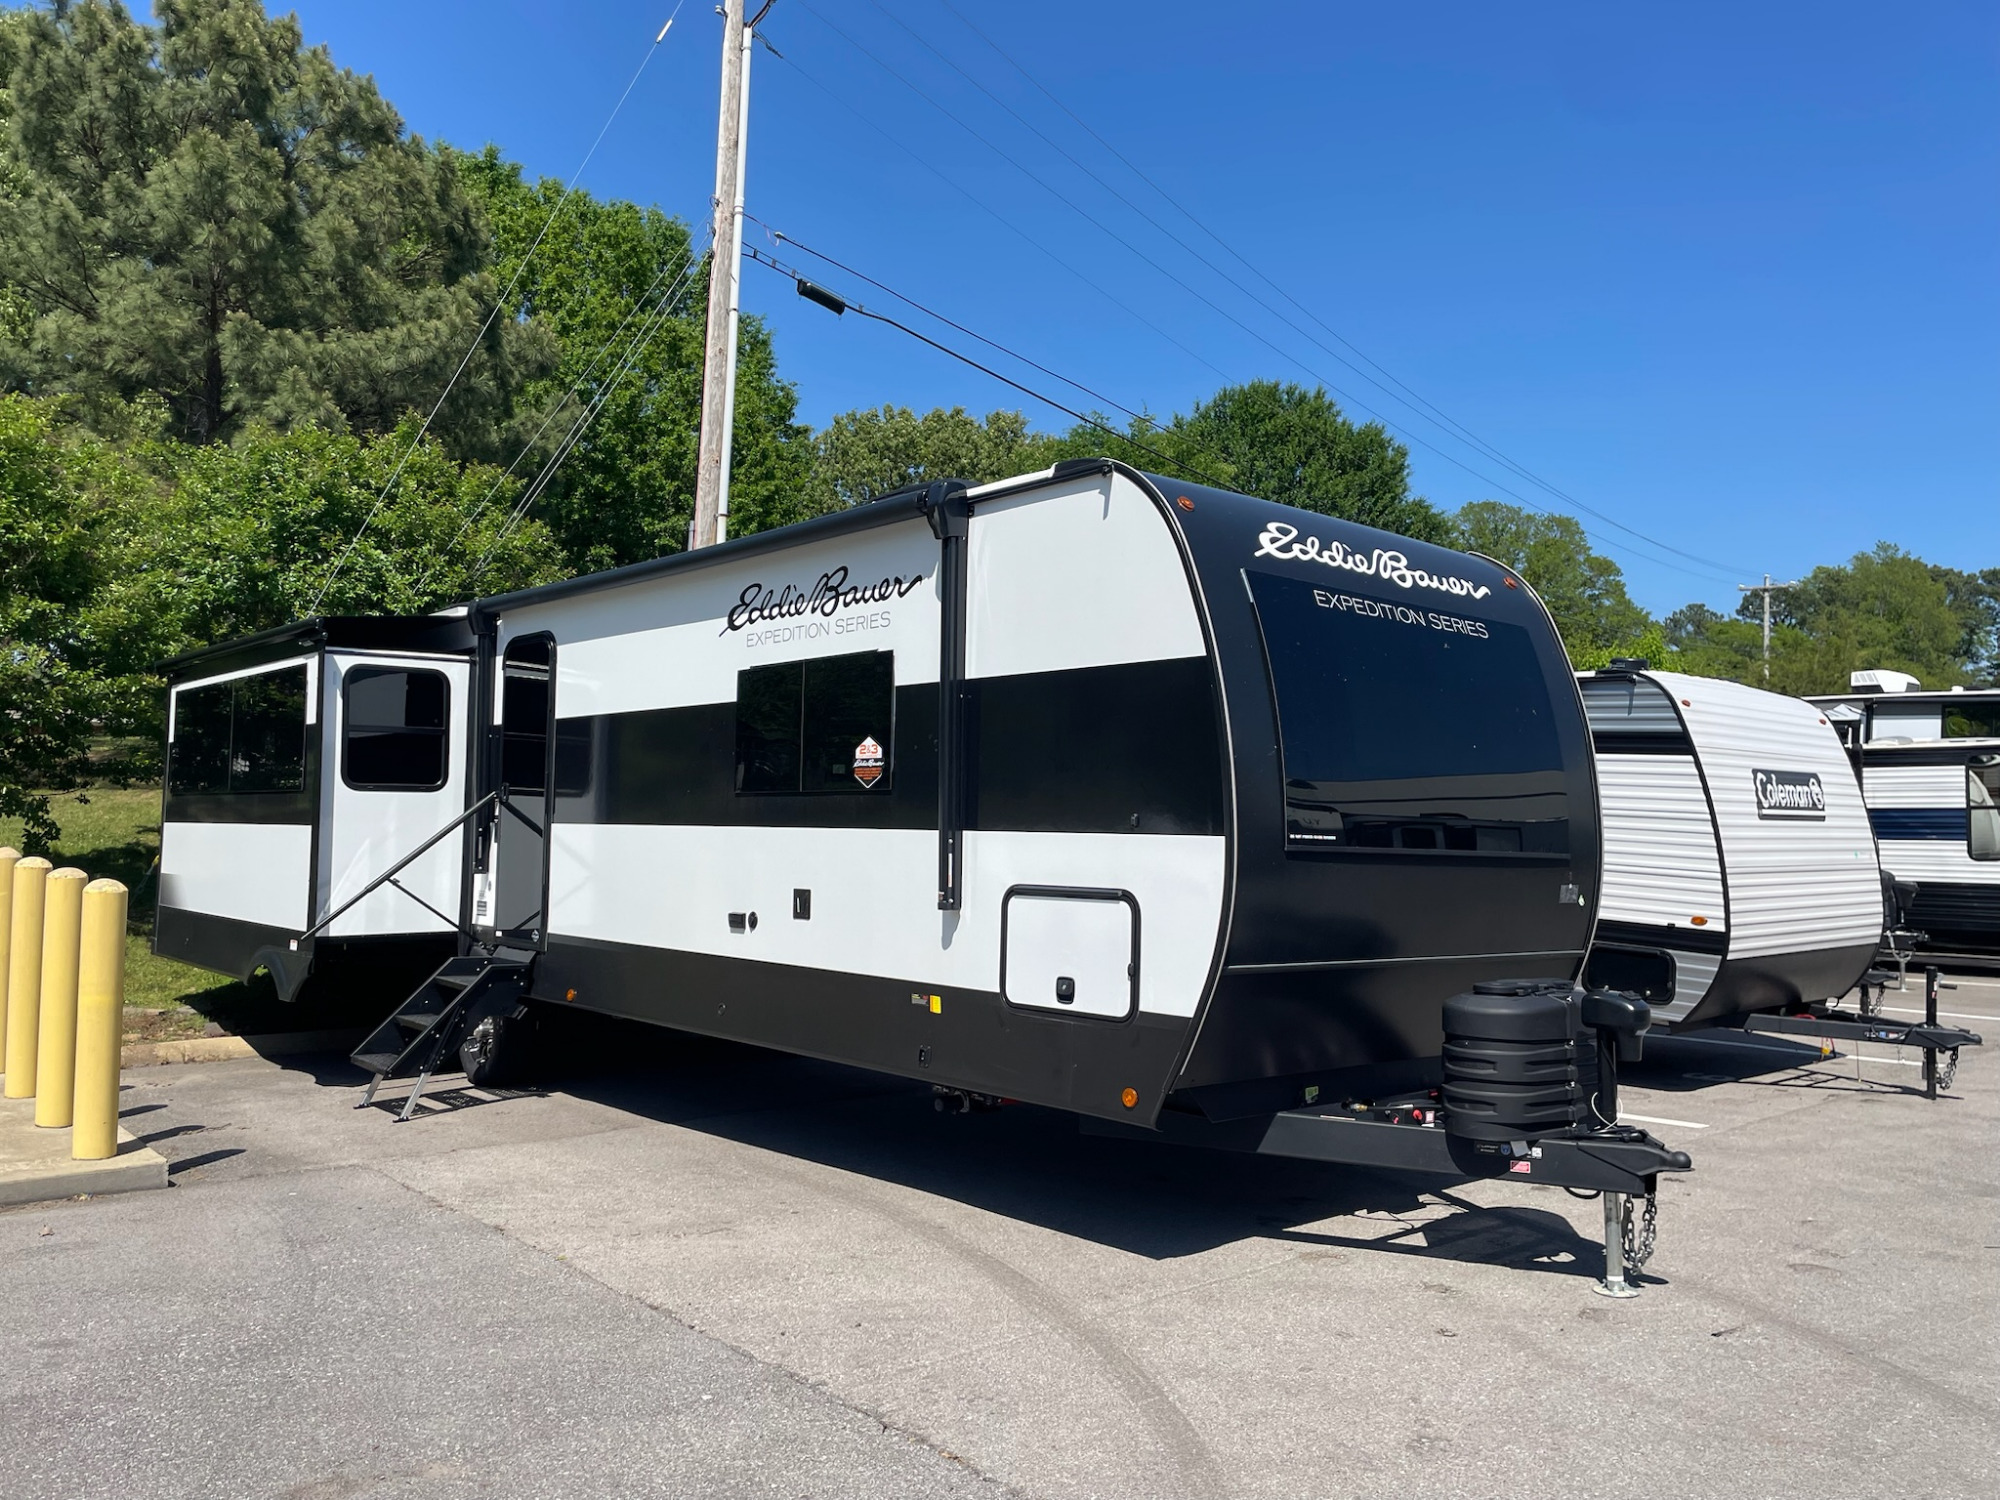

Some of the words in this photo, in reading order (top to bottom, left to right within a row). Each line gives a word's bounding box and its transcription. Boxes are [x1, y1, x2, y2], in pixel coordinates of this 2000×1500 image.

[1254, 522, 1372, 573] Eddie
[1370, 549, 1491, 600] Bauer
[719, 583, 806, 637] Eddie
[804, 566, 923, 617] Bauer
[1313, 589, 1426, 627] EXPEDITION
[1428, 612, 1489, 639] SERIES
[746, 620, 830, 648] EXPEDITION
[834, 611, 891, 634] SERIES
[1756, 771, 1813, 809] Coleman
